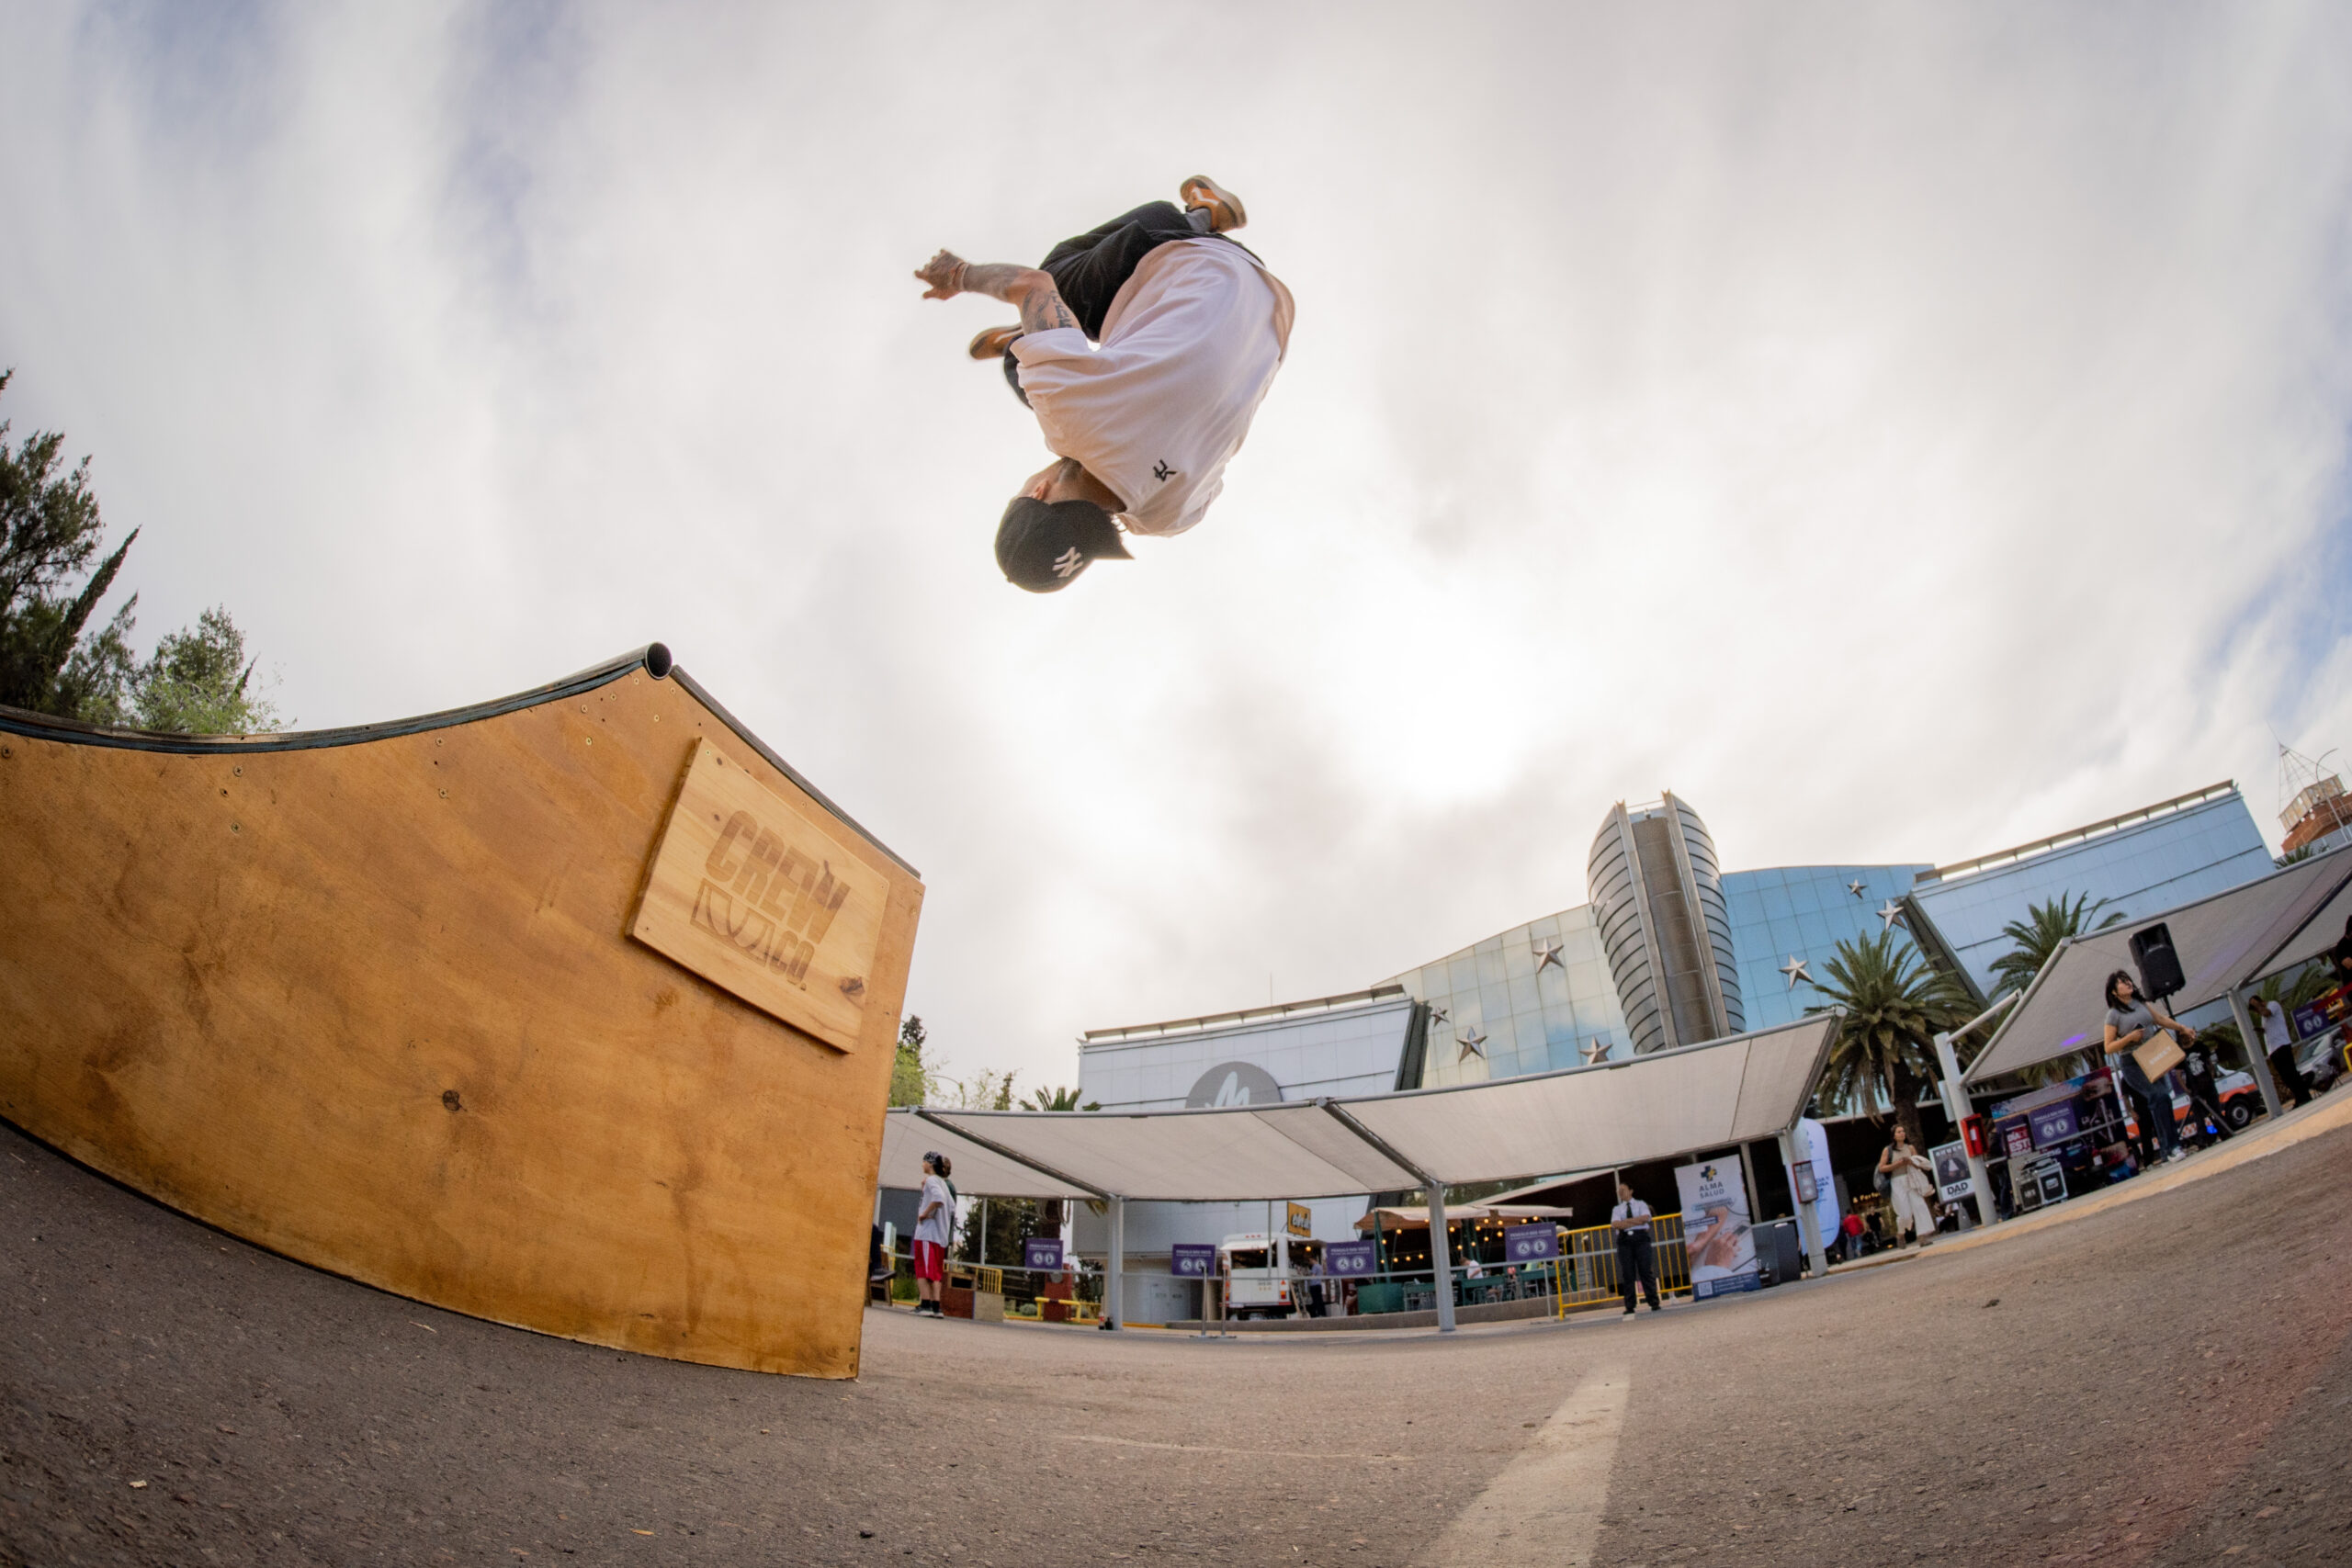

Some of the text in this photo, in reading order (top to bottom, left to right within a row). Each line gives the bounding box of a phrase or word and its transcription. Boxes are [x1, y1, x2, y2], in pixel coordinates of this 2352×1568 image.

[706, 810, 852, 944] CREW
[1699, 1181, 1724, 1192] ALMA
[1947, 1182, 1969, 1195] DAD
[1700, 1189, 1725, 1199] SALUD
